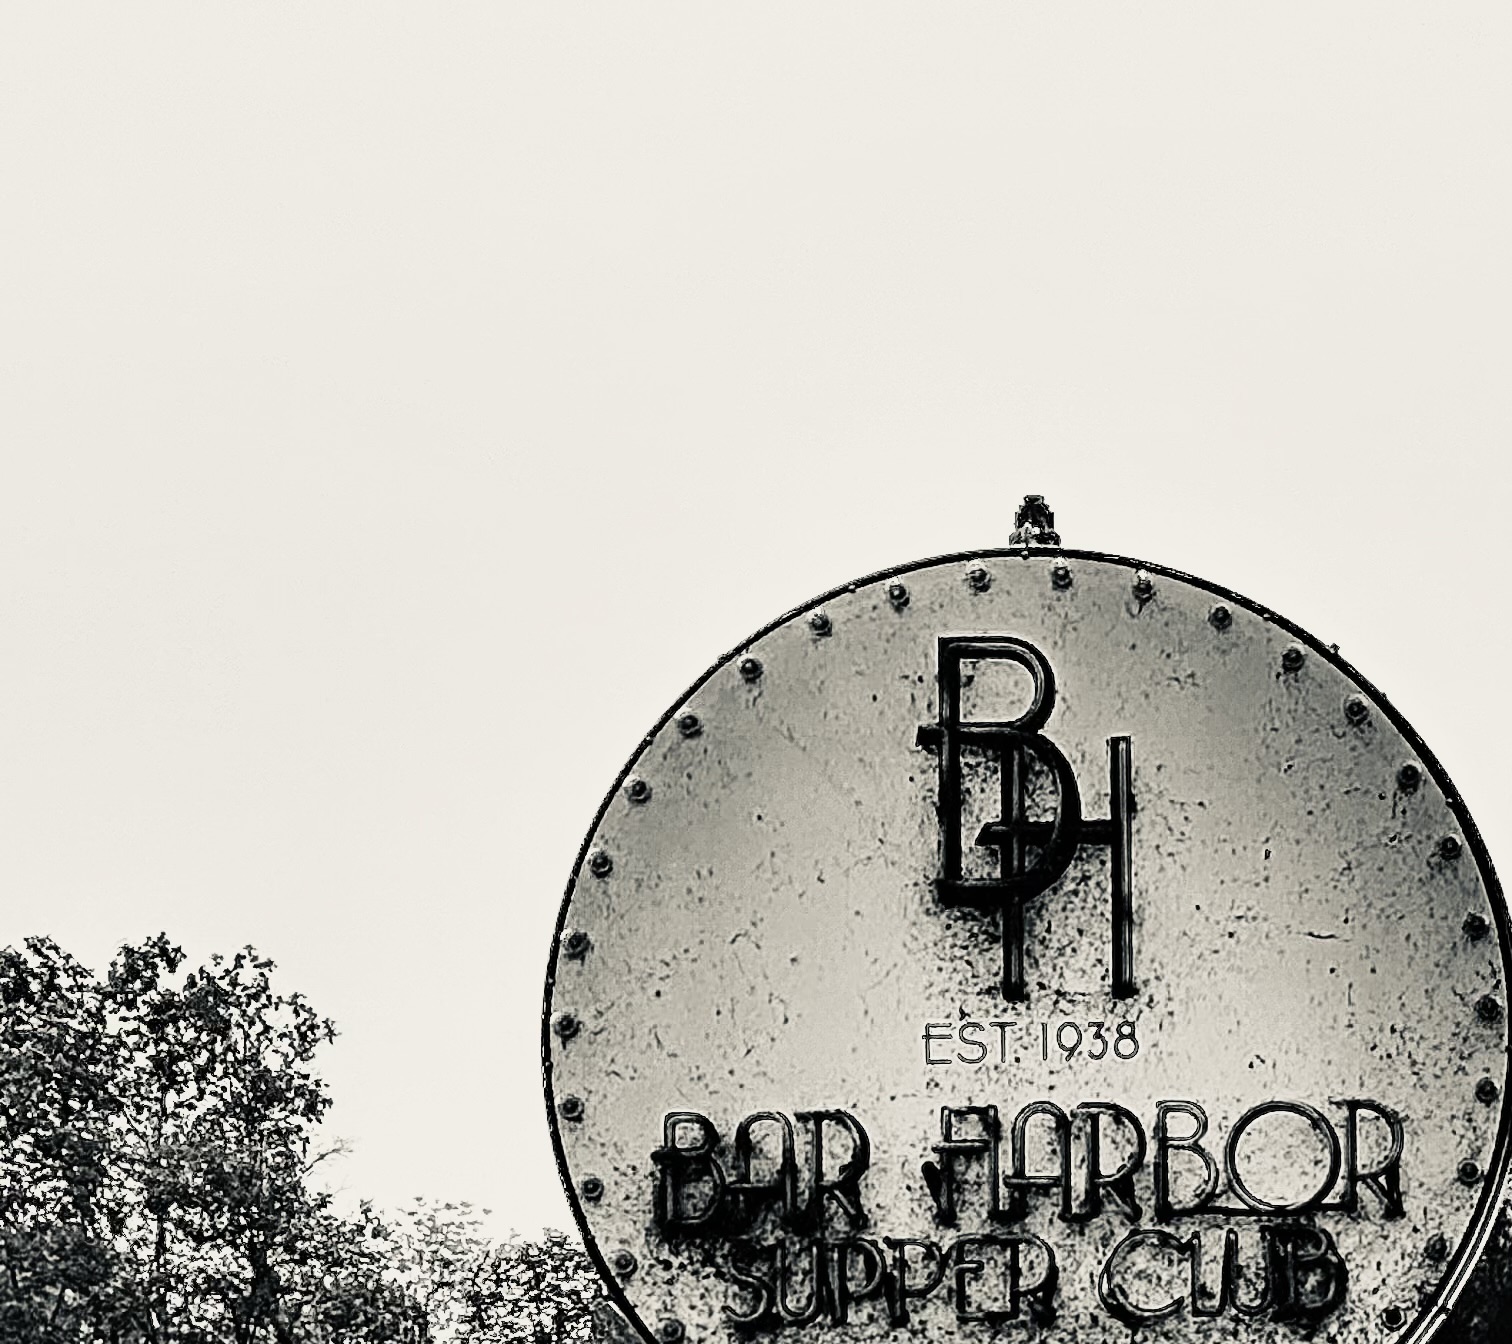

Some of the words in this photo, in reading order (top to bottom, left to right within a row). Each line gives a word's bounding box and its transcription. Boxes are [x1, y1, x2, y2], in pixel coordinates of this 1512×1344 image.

[1041, 1020, 1140, 1061] 1938
[651, 1110, 871, 1231] BAR
[922, 1100, 1405, 1222] HARBOR
[723, 1233, 1058, 1328] SUPPER
[1098, 1227, 1348, 1328] CLUB
